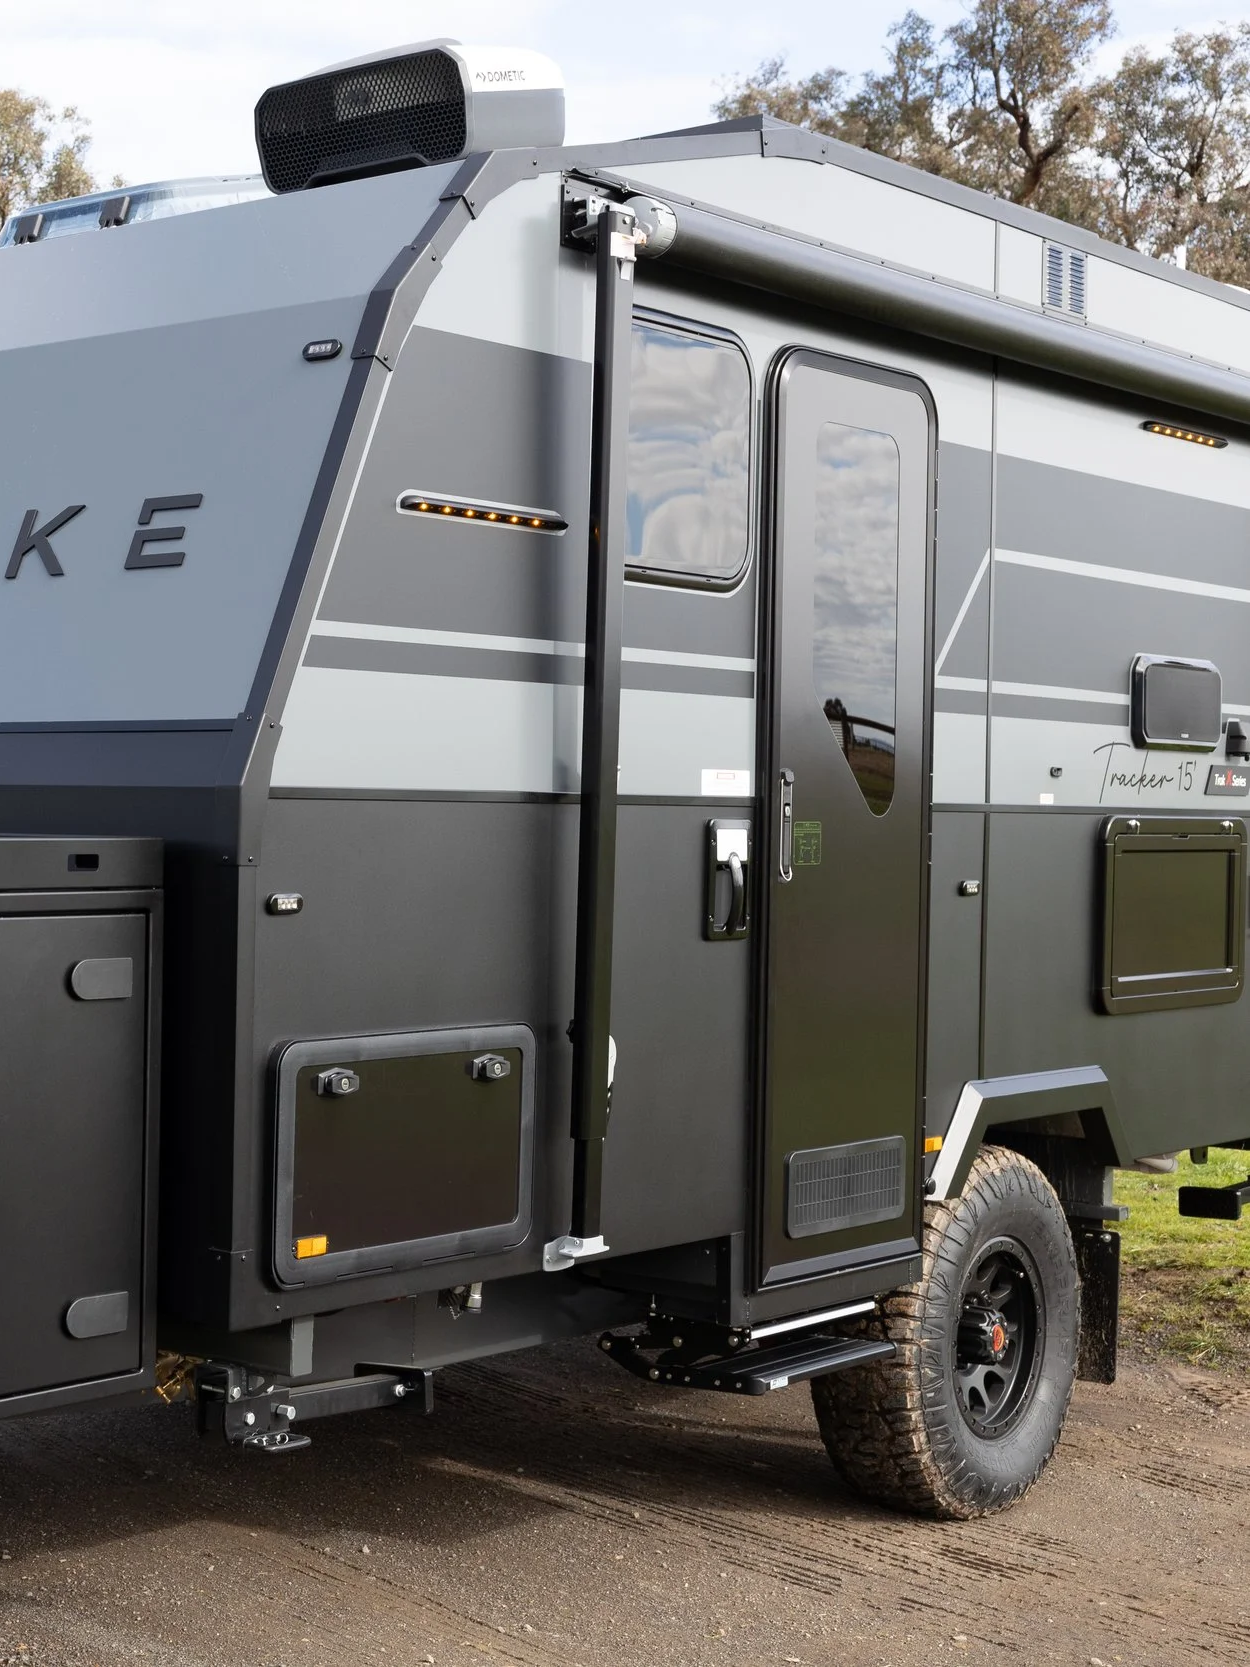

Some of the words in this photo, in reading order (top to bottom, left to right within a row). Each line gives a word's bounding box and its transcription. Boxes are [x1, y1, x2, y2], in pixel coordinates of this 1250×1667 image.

[487, 70, 526, 82] DOMETIC
[1093, 741, 1174, 804] Tracker
[1232, 774, 1247, 787] Series
